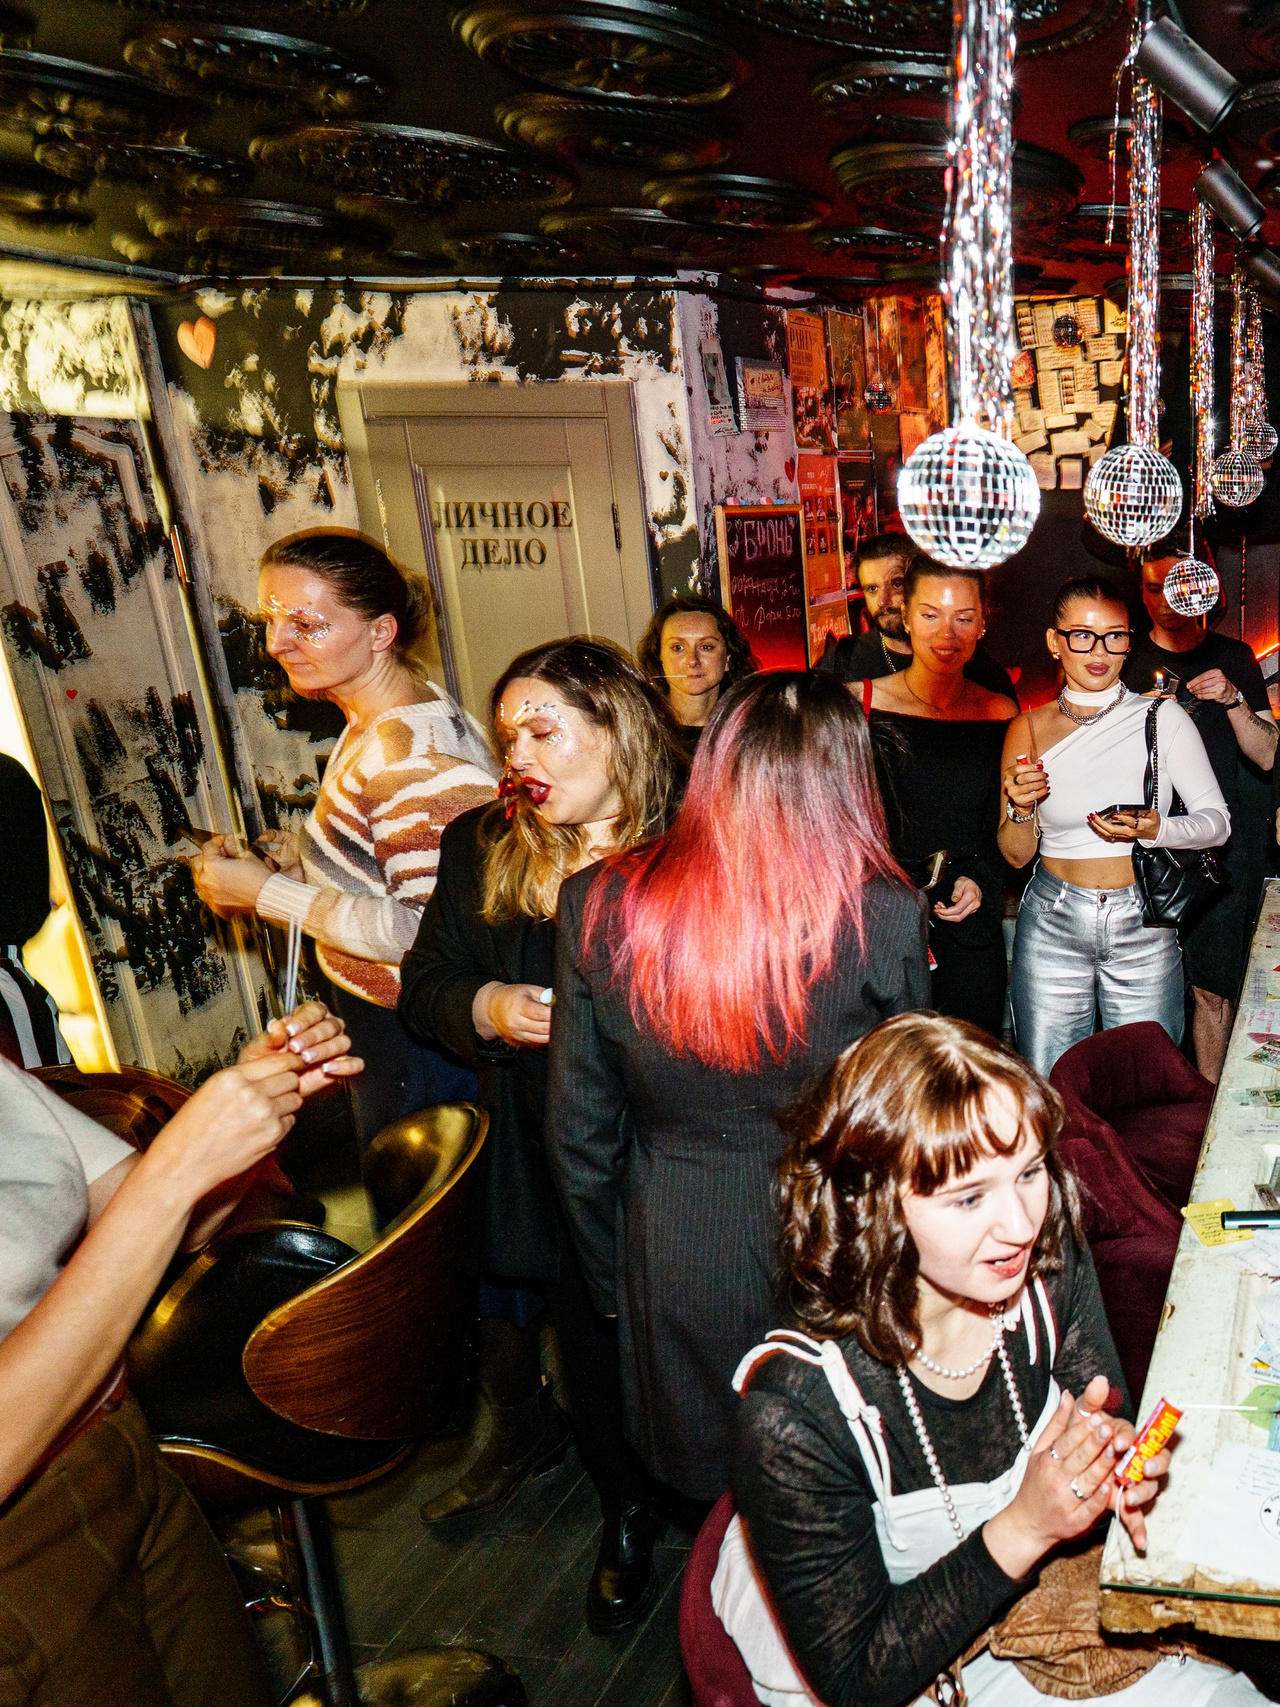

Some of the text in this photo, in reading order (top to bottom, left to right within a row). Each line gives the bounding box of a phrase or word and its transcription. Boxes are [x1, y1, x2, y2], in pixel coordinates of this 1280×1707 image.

[434, 501, 573, 528] ЛИЧНОЕ
[461, 538, 547, 570] ДЕЛО
[743, 519, 793, 561] БРОНЬ
